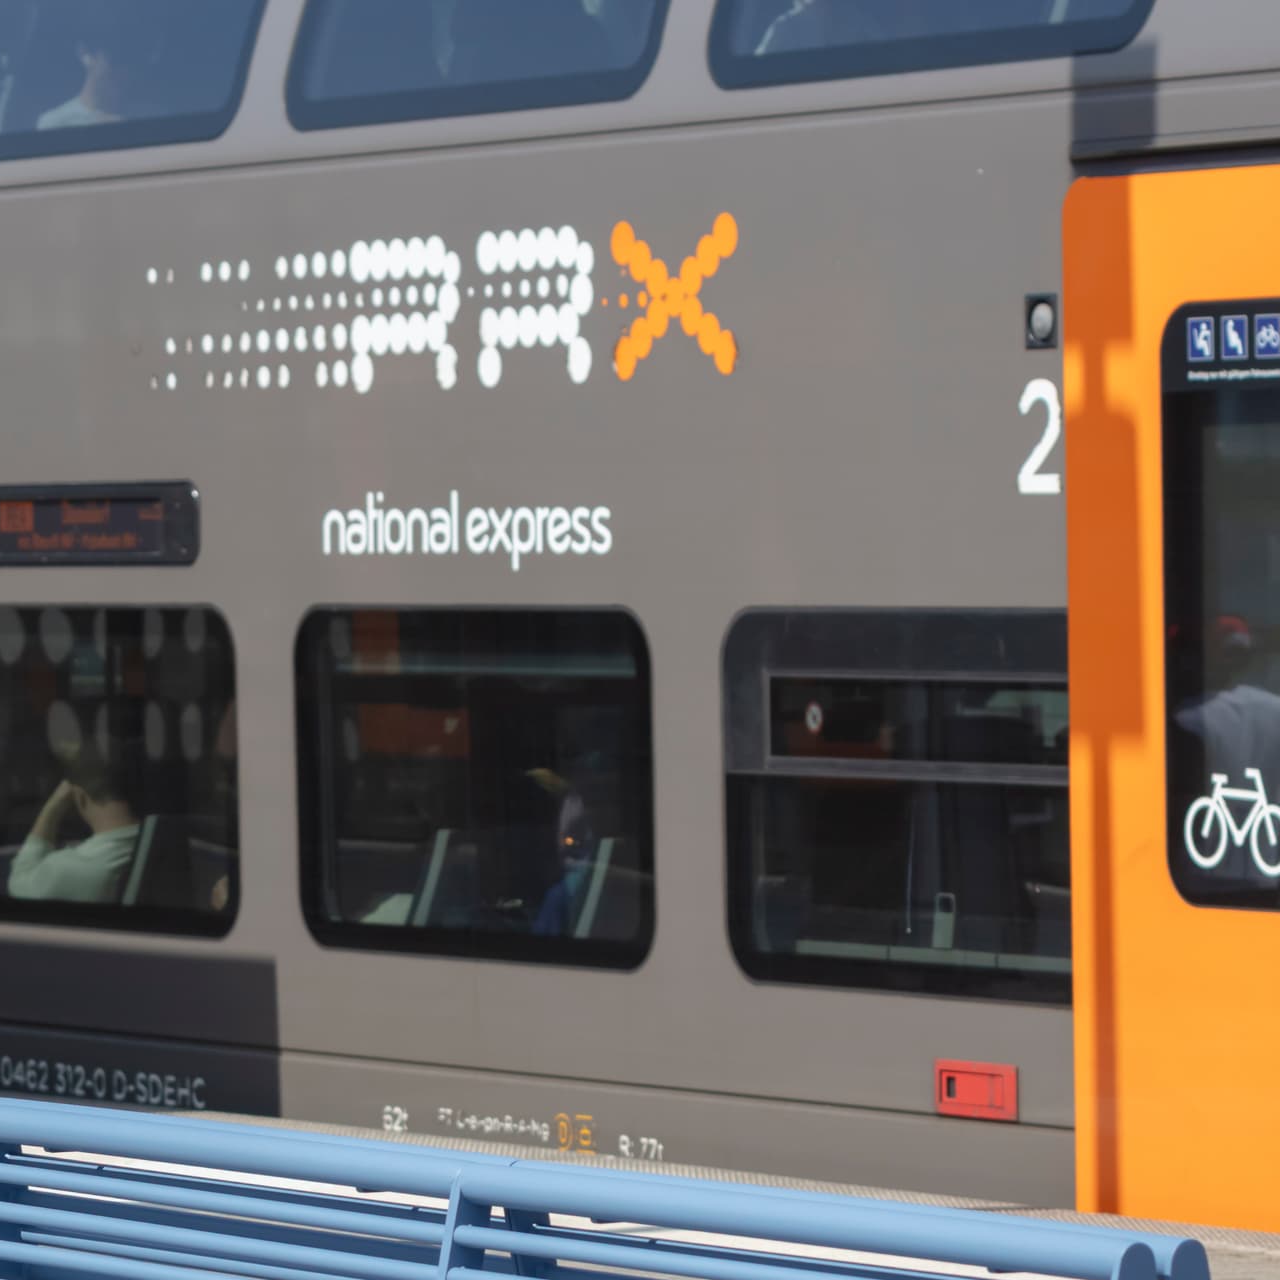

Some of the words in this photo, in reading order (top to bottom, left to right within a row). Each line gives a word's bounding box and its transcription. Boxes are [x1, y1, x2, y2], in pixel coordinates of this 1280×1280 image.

[1017, 377, 1062, 494] 2
[321, 489, 459, 555] national
[466, 505, 613, 572] express
[0, 1055, 49, 1092] 0462
[55, 1062, 107, 1099] 312-0
[113, 1069, 207, 1109] D-SDEHC
